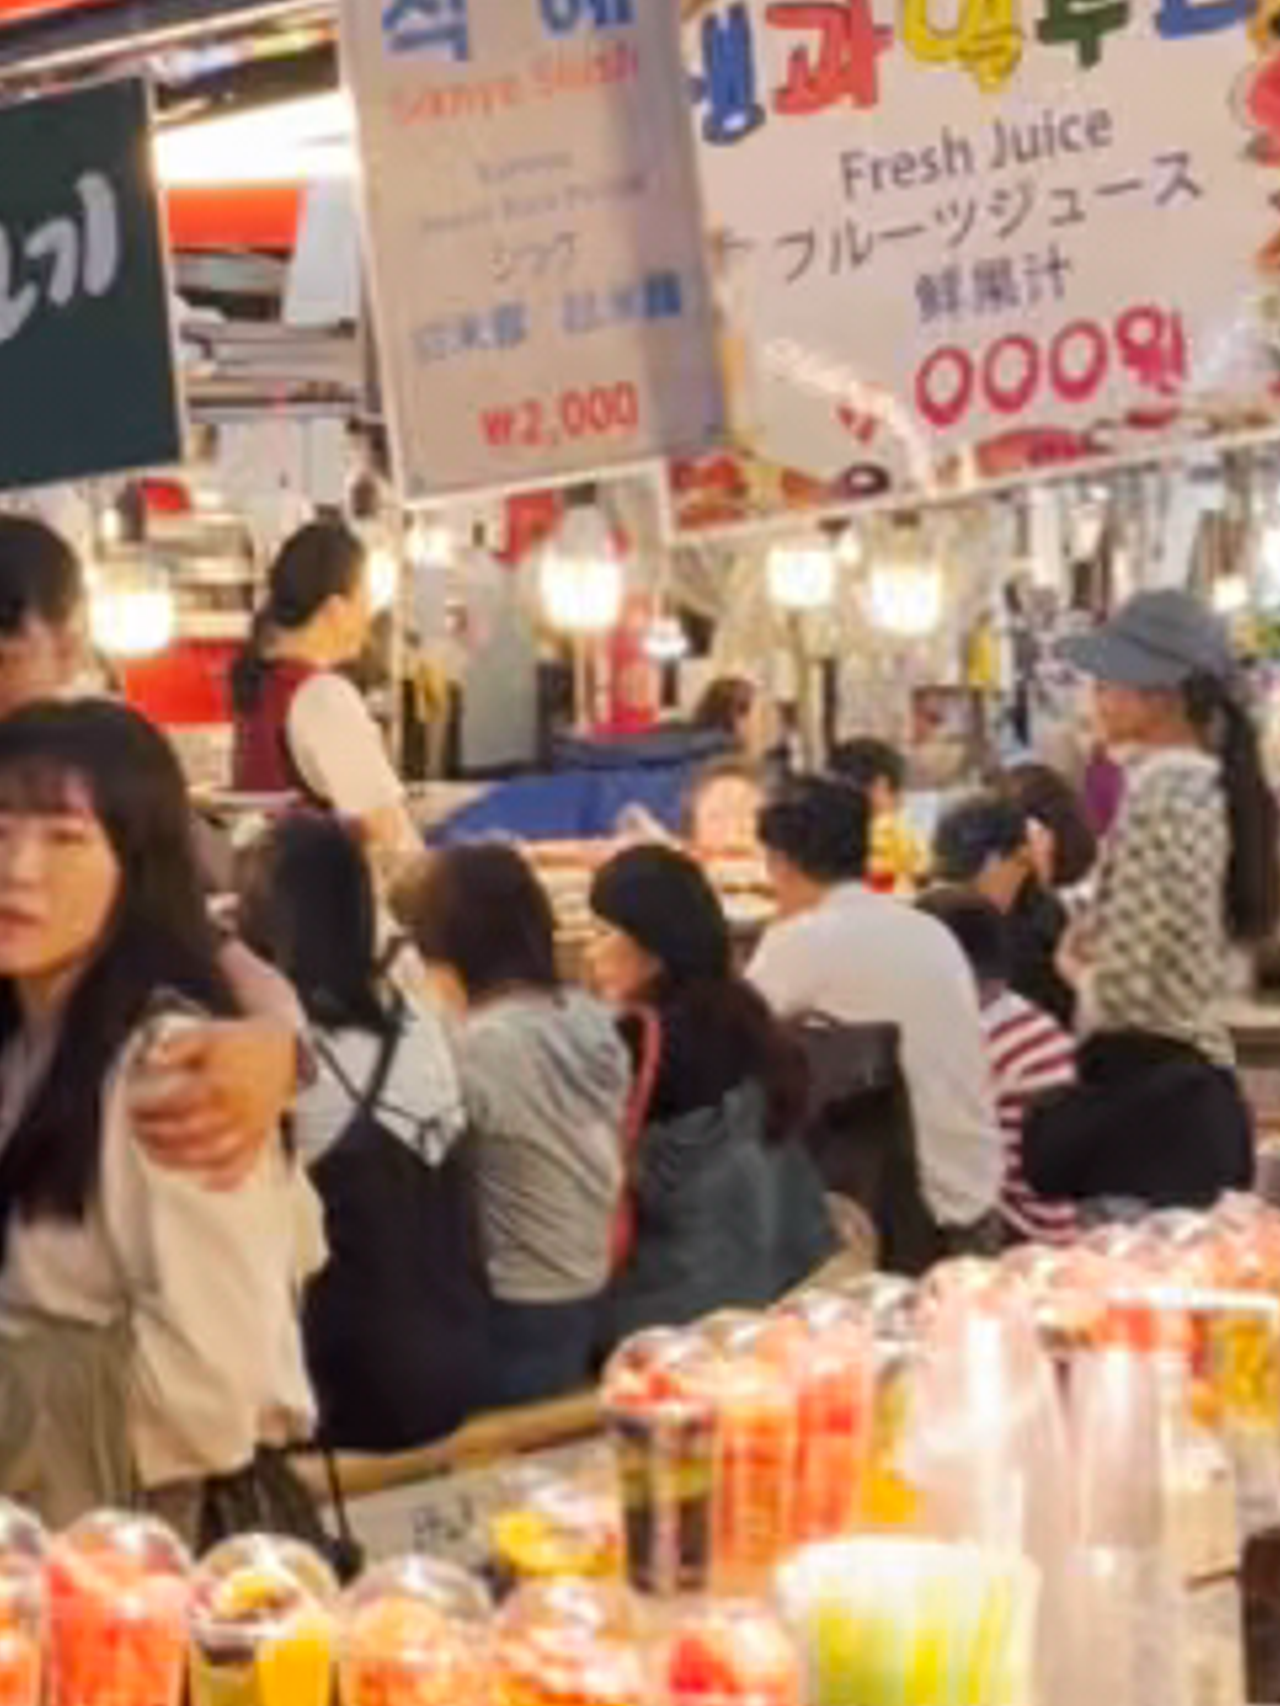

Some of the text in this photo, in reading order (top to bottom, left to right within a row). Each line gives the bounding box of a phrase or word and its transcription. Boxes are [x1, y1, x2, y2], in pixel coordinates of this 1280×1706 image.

[839, 108, 1113, 200] Fresh Juice
[773, 151, 1205, 284] フルーツジュース
